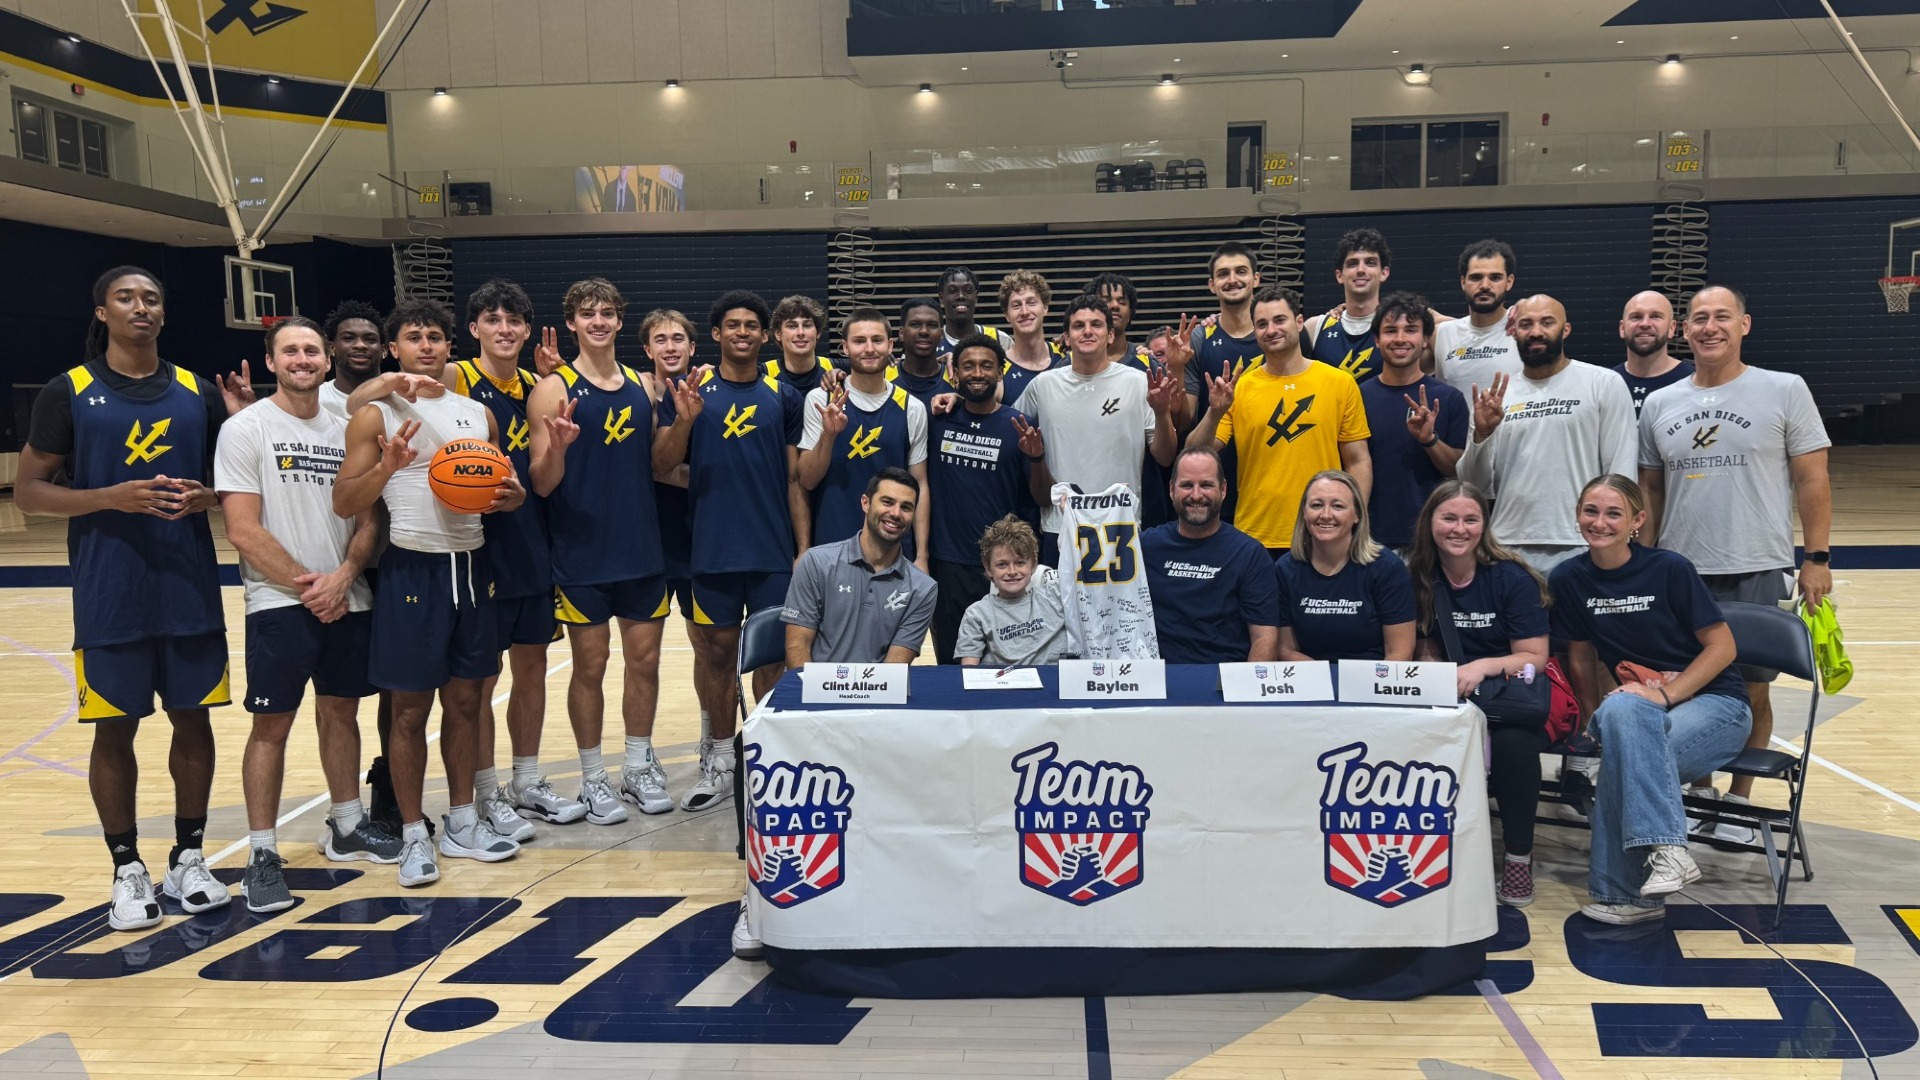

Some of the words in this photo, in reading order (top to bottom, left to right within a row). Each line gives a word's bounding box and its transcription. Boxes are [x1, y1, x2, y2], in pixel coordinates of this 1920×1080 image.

[1667, 145, 1691, 156] 103
[1263, 159, 1287, 170] 102
[1674, 161, 1699, 172] 104
[840, 175, 860, 185] 101
[1272, 175, 1295, 186] 103
[418, 192, 440, 203] 101
[847, 190, 870, 201] 102
[1505, 407, 1572, 421] BASKETBALL
[1666, 422, 1682, 436] UC
[1685, 410, 1710, 424] SAN
[1714, 410, 1752, 429] DIEGO
[944, 429, 955, 439] UC
[955, 432, 975, 443] SAN
[975, 435, 1002, 447] DIEGO
[273, 443, 288, 452] UC
[312, 445, 346, 458] DIEGO
[444, 442, 499, 457] Wilson
[955, 446, 993, 458] BASKETBALL
[941, 454, 997, 471] TRITONS
[1668, 454, 1748, 472] BASKETBALL
[453, 464, 493, 476] NCAA
[1068, 493, 1132, 509] RITONS
[1076, 522, 1138, 586] 23
[1167, 569, 1215, 579] BASKETBALL
[1594, 603, 1650, 614] BASKETBALL
[822, 682, 849, 691] Clint
[851, 682, 888, 691] Allard
[1087, 681, 1139, 692] Baylen
[1261, 683, 1294, 696] Josh
[1374, 683, 1421, 696] Laura
[1014, 744, 1151, 806] Team
[1320, 744, 1459, 807] Team
[757, 811, 847, 831] PACT
[1019, 811, 1145, 829] IMPACT
[1325, 811, 1453, 830] IMPACT
